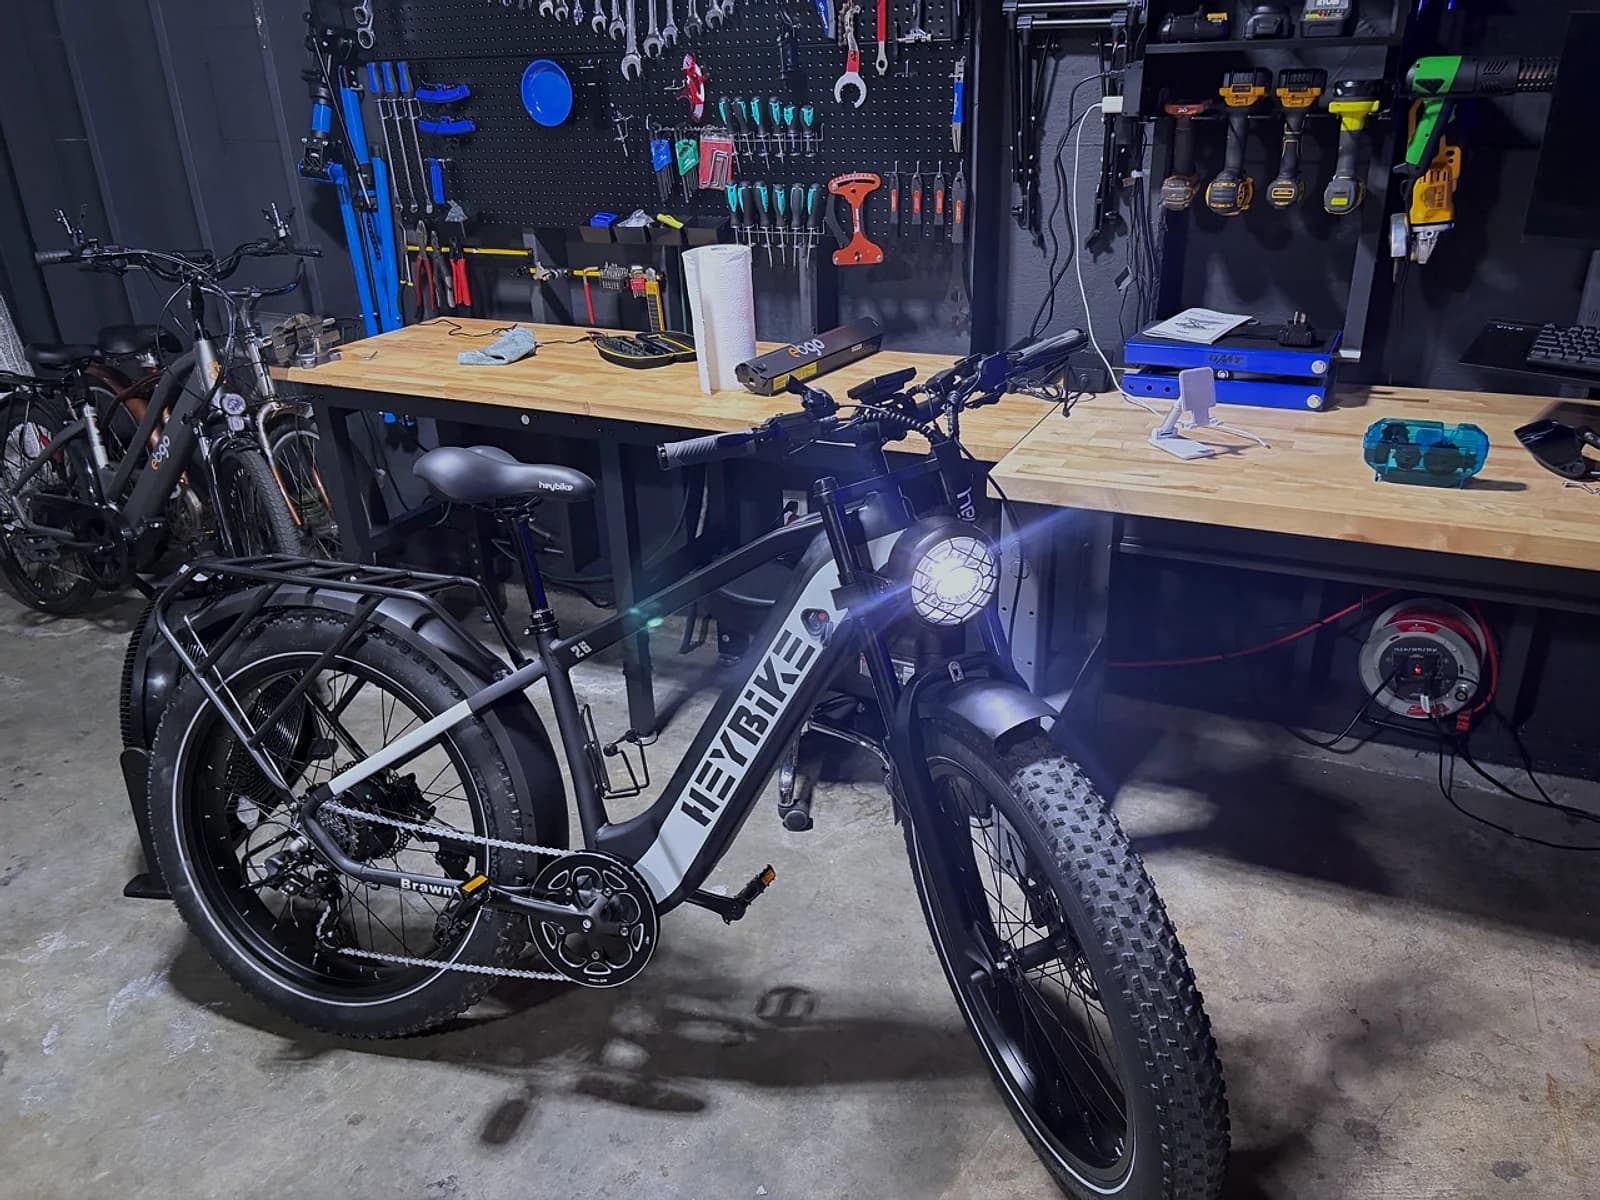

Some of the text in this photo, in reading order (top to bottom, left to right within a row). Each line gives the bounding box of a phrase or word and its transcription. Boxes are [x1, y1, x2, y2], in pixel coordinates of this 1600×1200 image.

[151, 435, 170, 471] ebgo
[538, 480, 574, 491] heybike
[400, 878, 453, 896] Brawn
